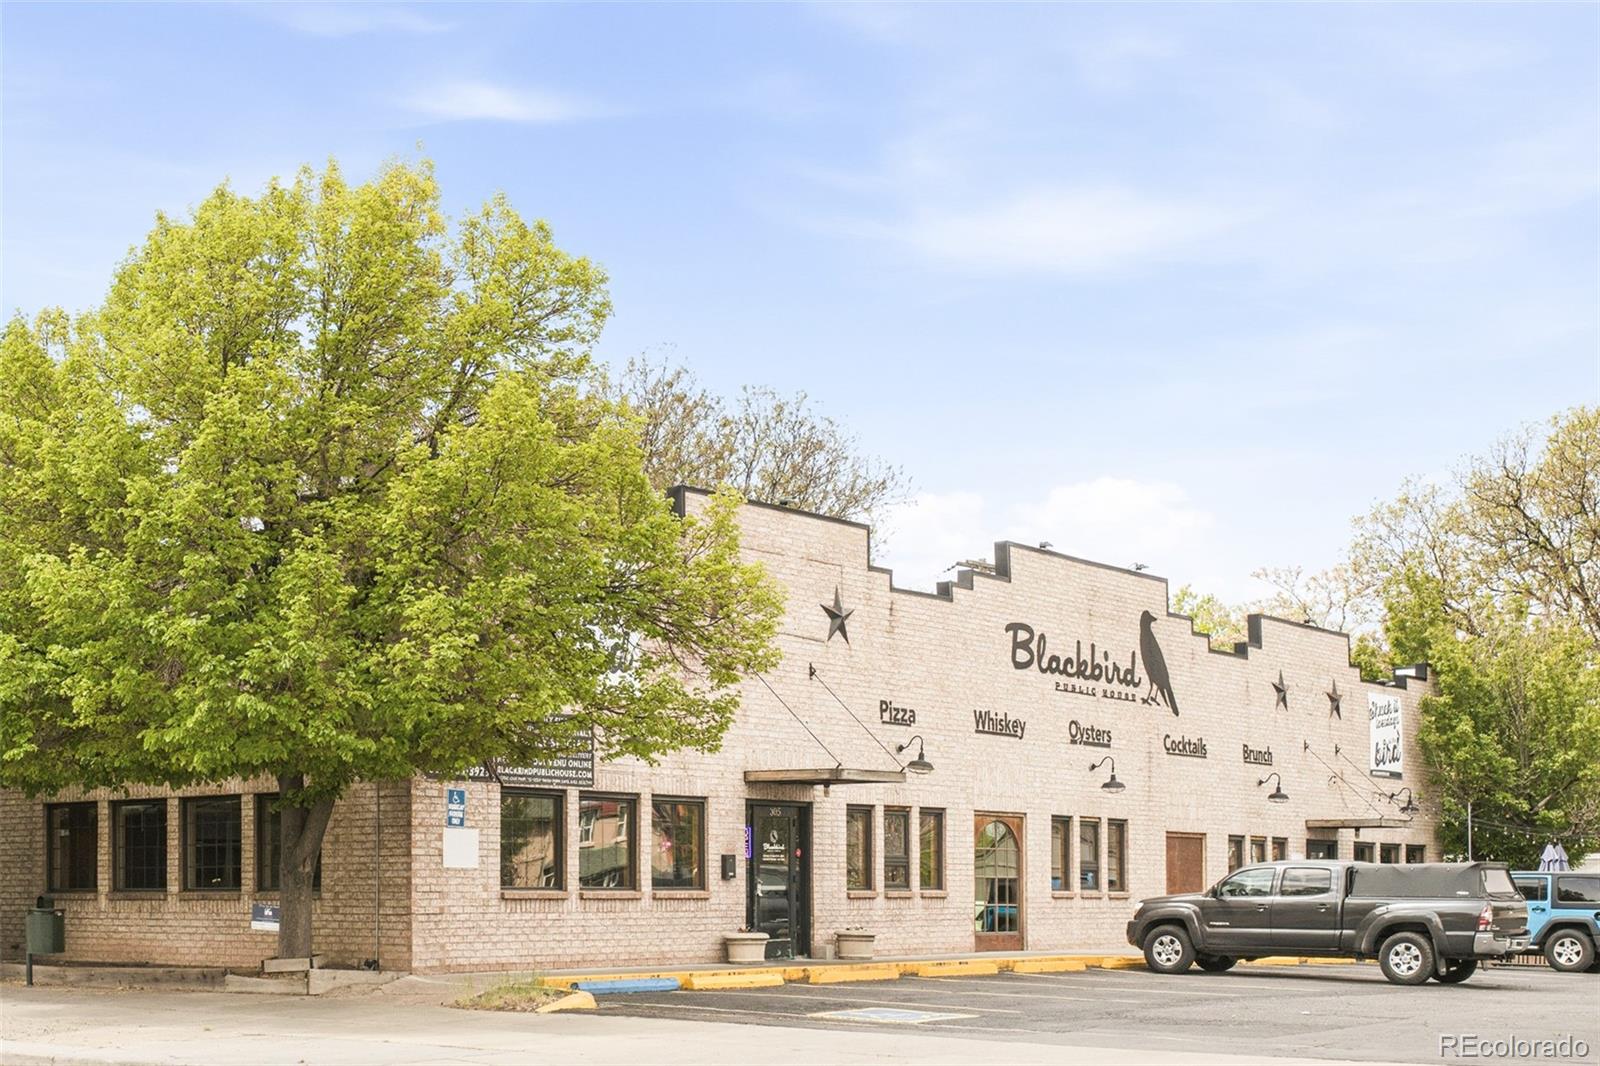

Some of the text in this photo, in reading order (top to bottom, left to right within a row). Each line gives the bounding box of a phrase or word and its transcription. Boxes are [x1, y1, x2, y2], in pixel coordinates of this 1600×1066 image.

[1005, 622, 1141, 688] Blackbird
[1055, 681, 1137, 702] PUBLIC HOUSE
[879, 699, 916, 725] Pizza
[973, 709, 1026, 740] Whiskey
[1068, 719, 1112, 747] Oysters
[1163, 733, 1208, 757] Cocktails
[567, 759, 592, 769] ONLINE
[1242, 743, 1273, 764] Brunch
